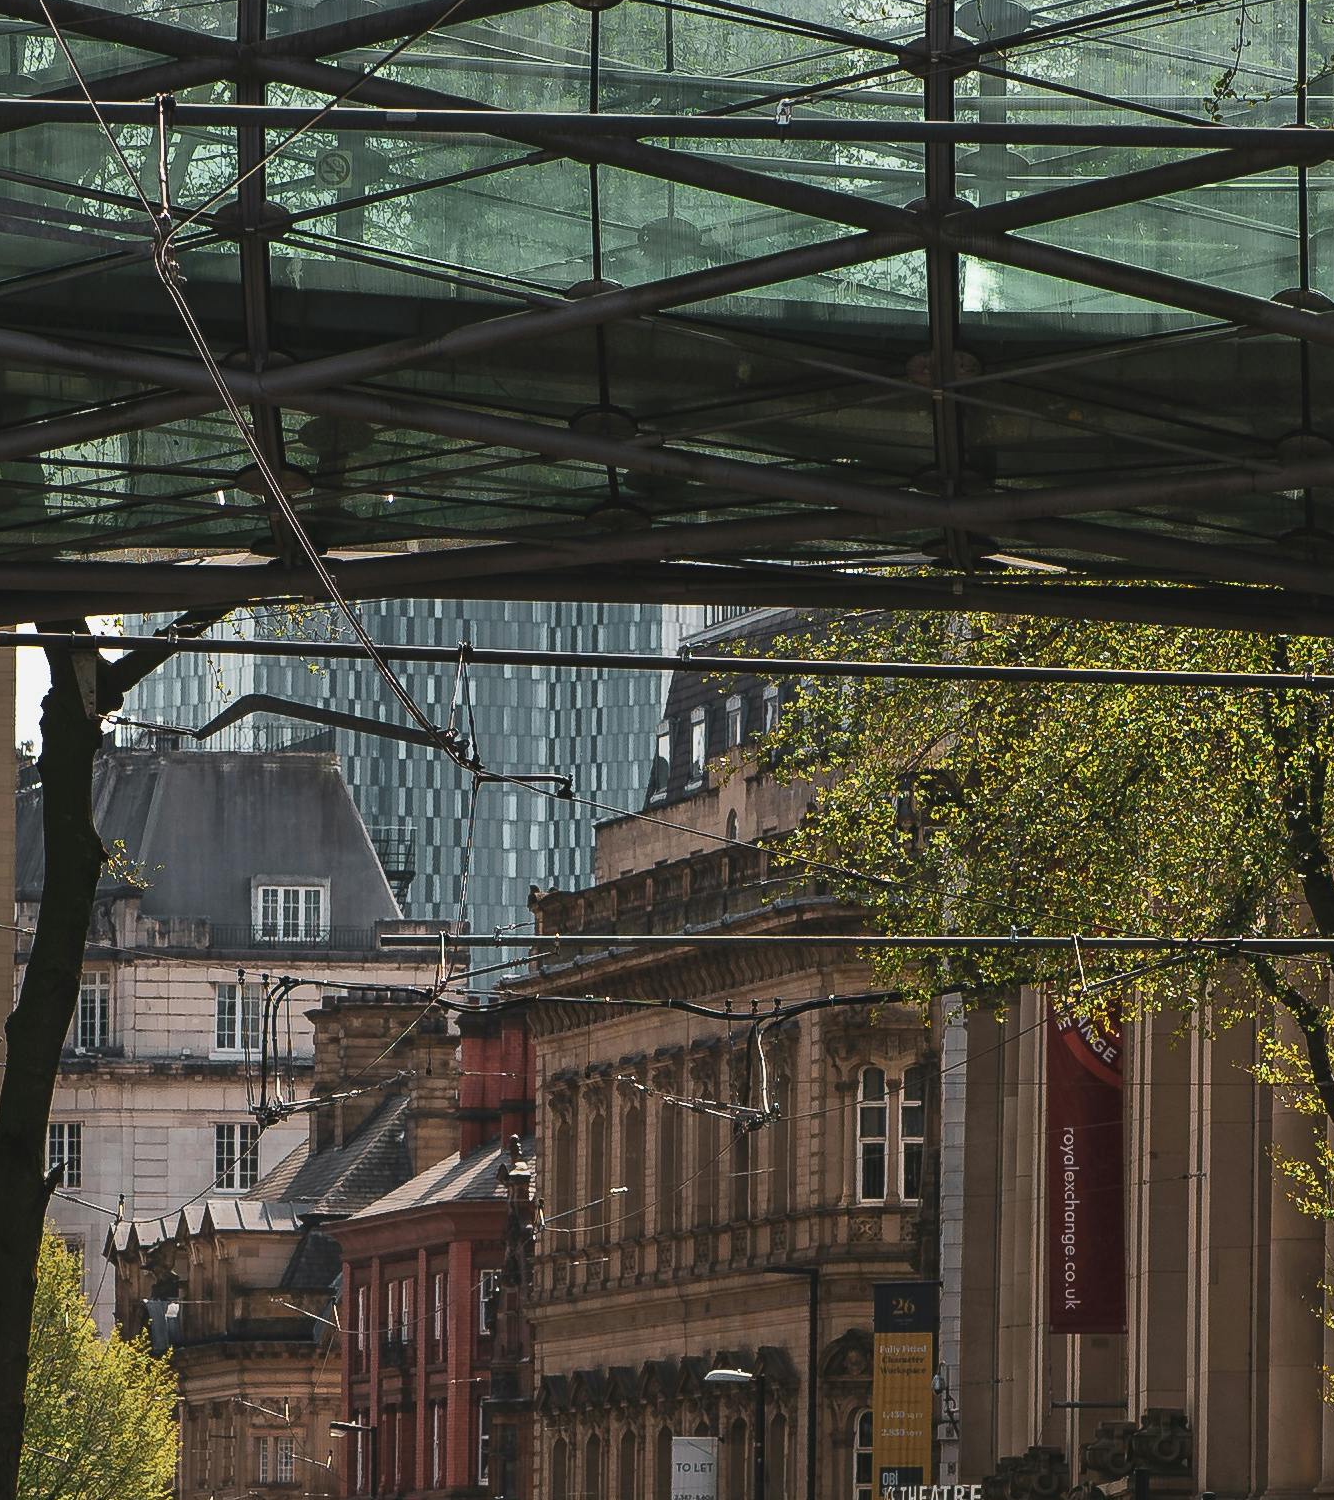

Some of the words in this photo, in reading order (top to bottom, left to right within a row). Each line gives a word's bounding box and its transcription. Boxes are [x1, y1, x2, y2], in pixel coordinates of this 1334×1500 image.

[1059, 1127, 1082, 1309] royalexchange.co.uk
[676, 1462, 692, 1473] TO
[693, 1462, 714, 1473] LET
